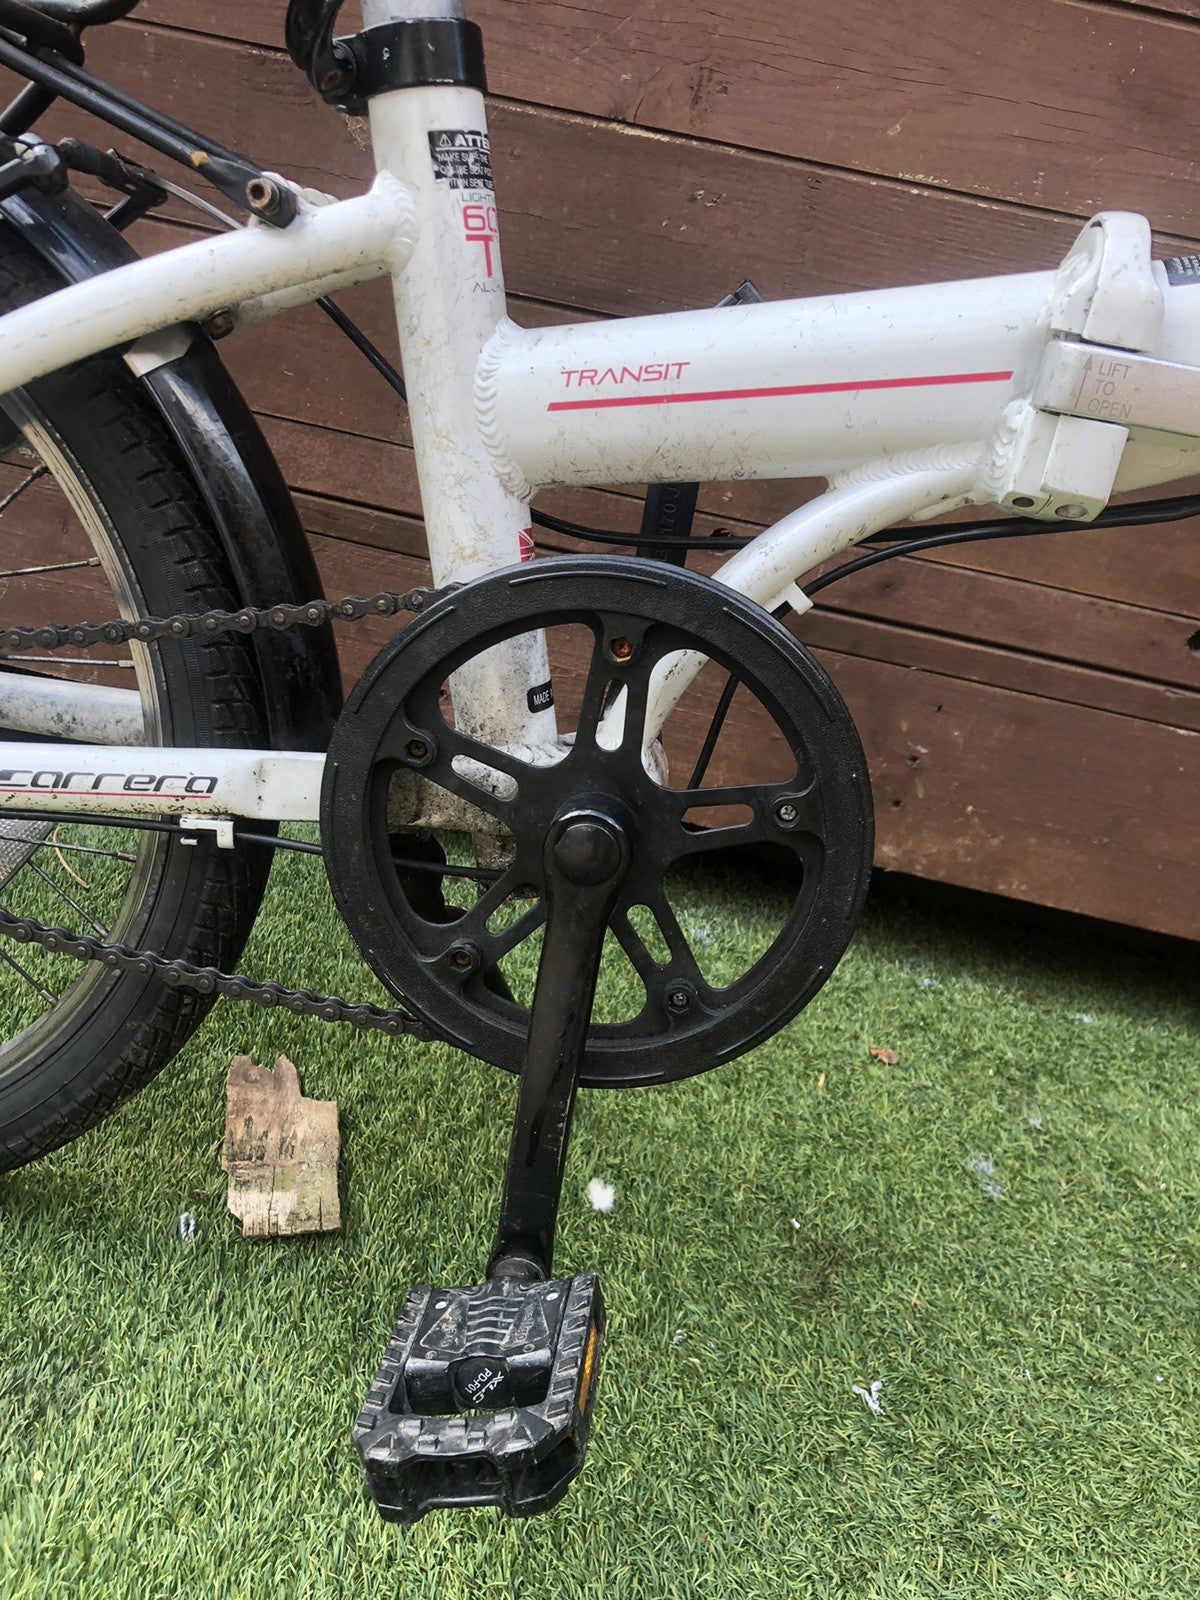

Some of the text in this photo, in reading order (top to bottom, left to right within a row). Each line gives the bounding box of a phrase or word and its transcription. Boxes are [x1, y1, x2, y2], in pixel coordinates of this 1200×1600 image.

[560, 362, 691, 388] TRANSIT
[1098, 361, 1133, 380] LIFT
[1095, 379, 1116, 396] TO
[1087, 398, 1132, 418] OPEN
[533, 690, 549, 706] MADE
[0, 769, 219, 794] carrera
[464, 1367, 493, 1394] PD-F01
